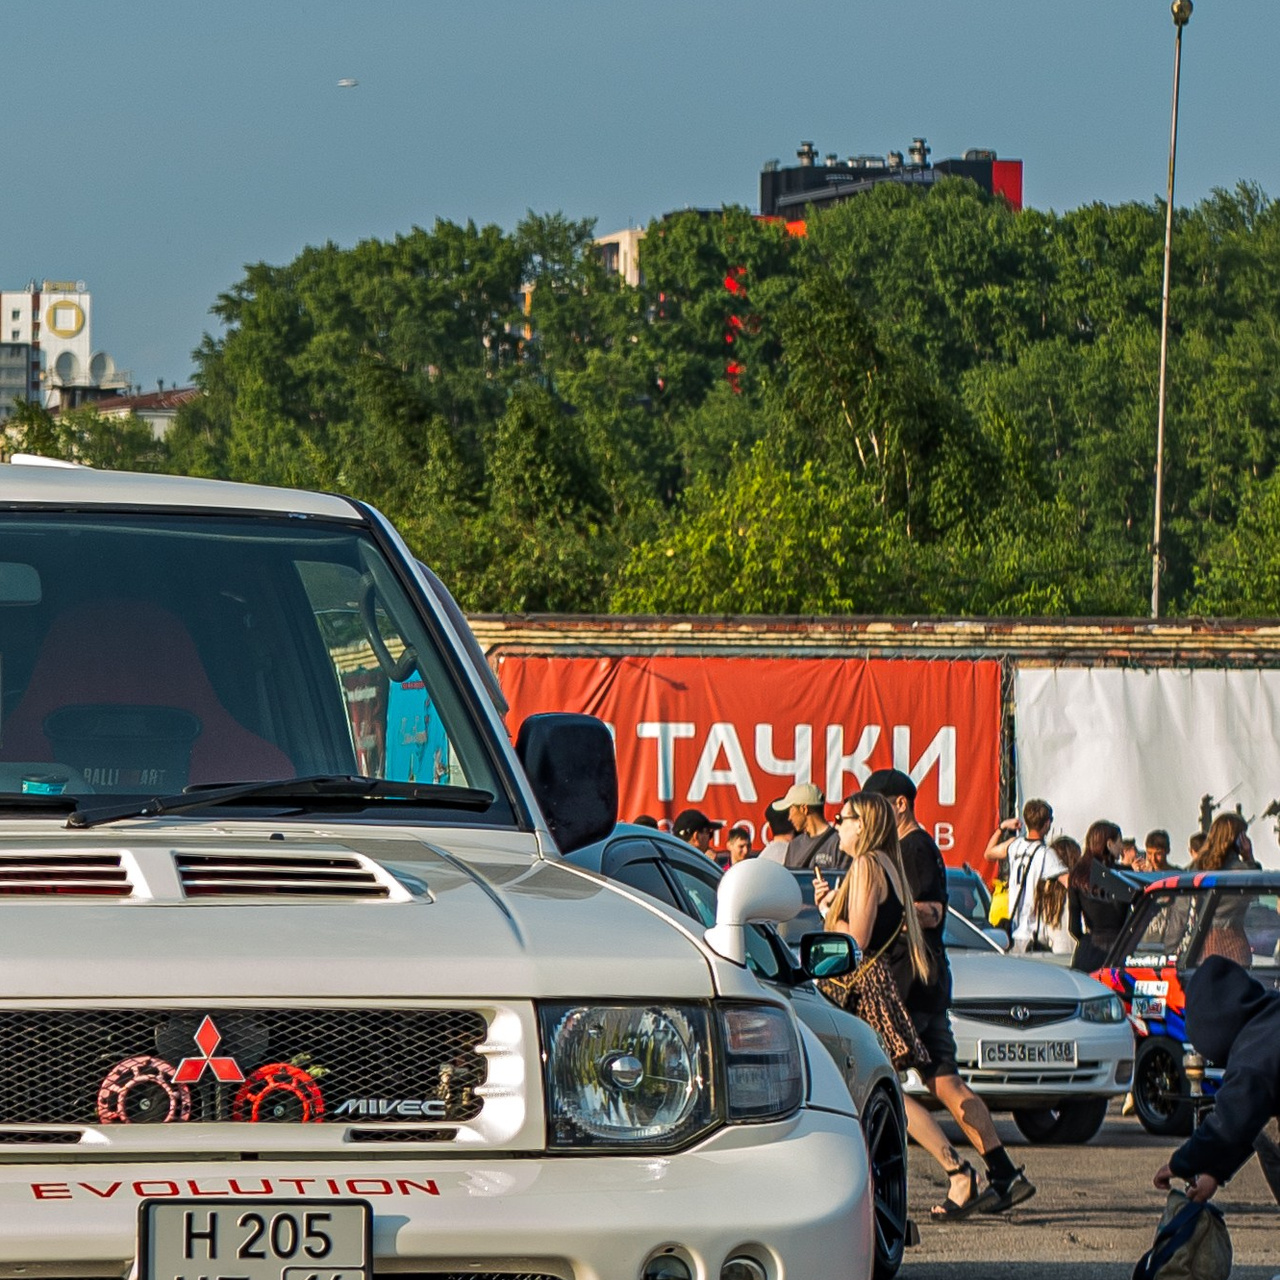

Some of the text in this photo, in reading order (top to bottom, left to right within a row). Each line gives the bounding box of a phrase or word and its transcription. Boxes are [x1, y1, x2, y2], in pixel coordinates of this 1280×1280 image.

[636, 722, 956, 806] ТАЧКИ
[987, 1042, 1046, 1063] С553ЕК
[333, 1099, 446, 1116] MIVEC
[30, 1178, 441, 1200] EVOLUTION
[184, 1211, 333, 1260] Н 205
